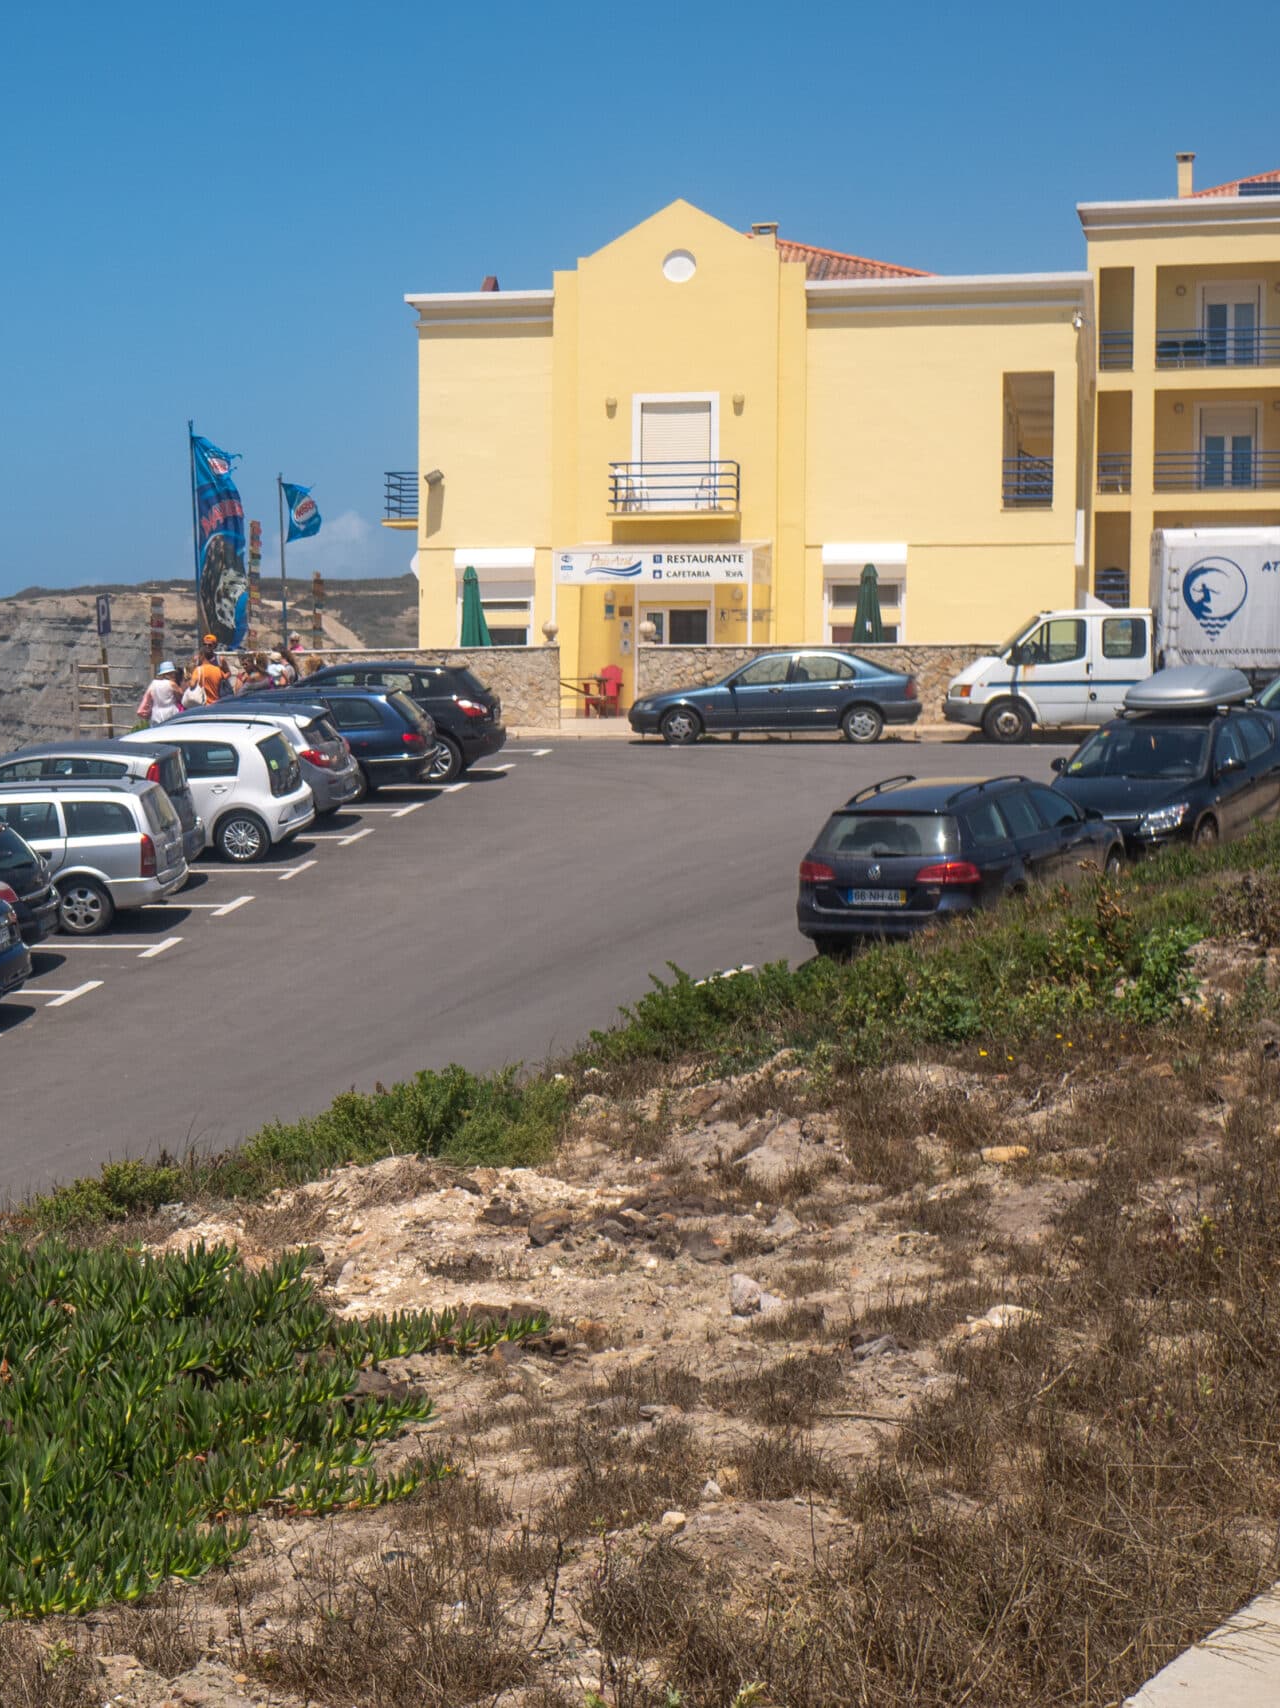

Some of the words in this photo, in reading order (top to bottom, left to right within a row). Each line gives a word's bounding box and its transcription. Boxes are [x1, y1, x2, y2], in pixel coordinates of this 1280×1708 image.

[666, 554, 744, 564] RESTAURANTE
[666, 570, 710, 578] CAFETARIA
[99, 599, 108, 634] P
